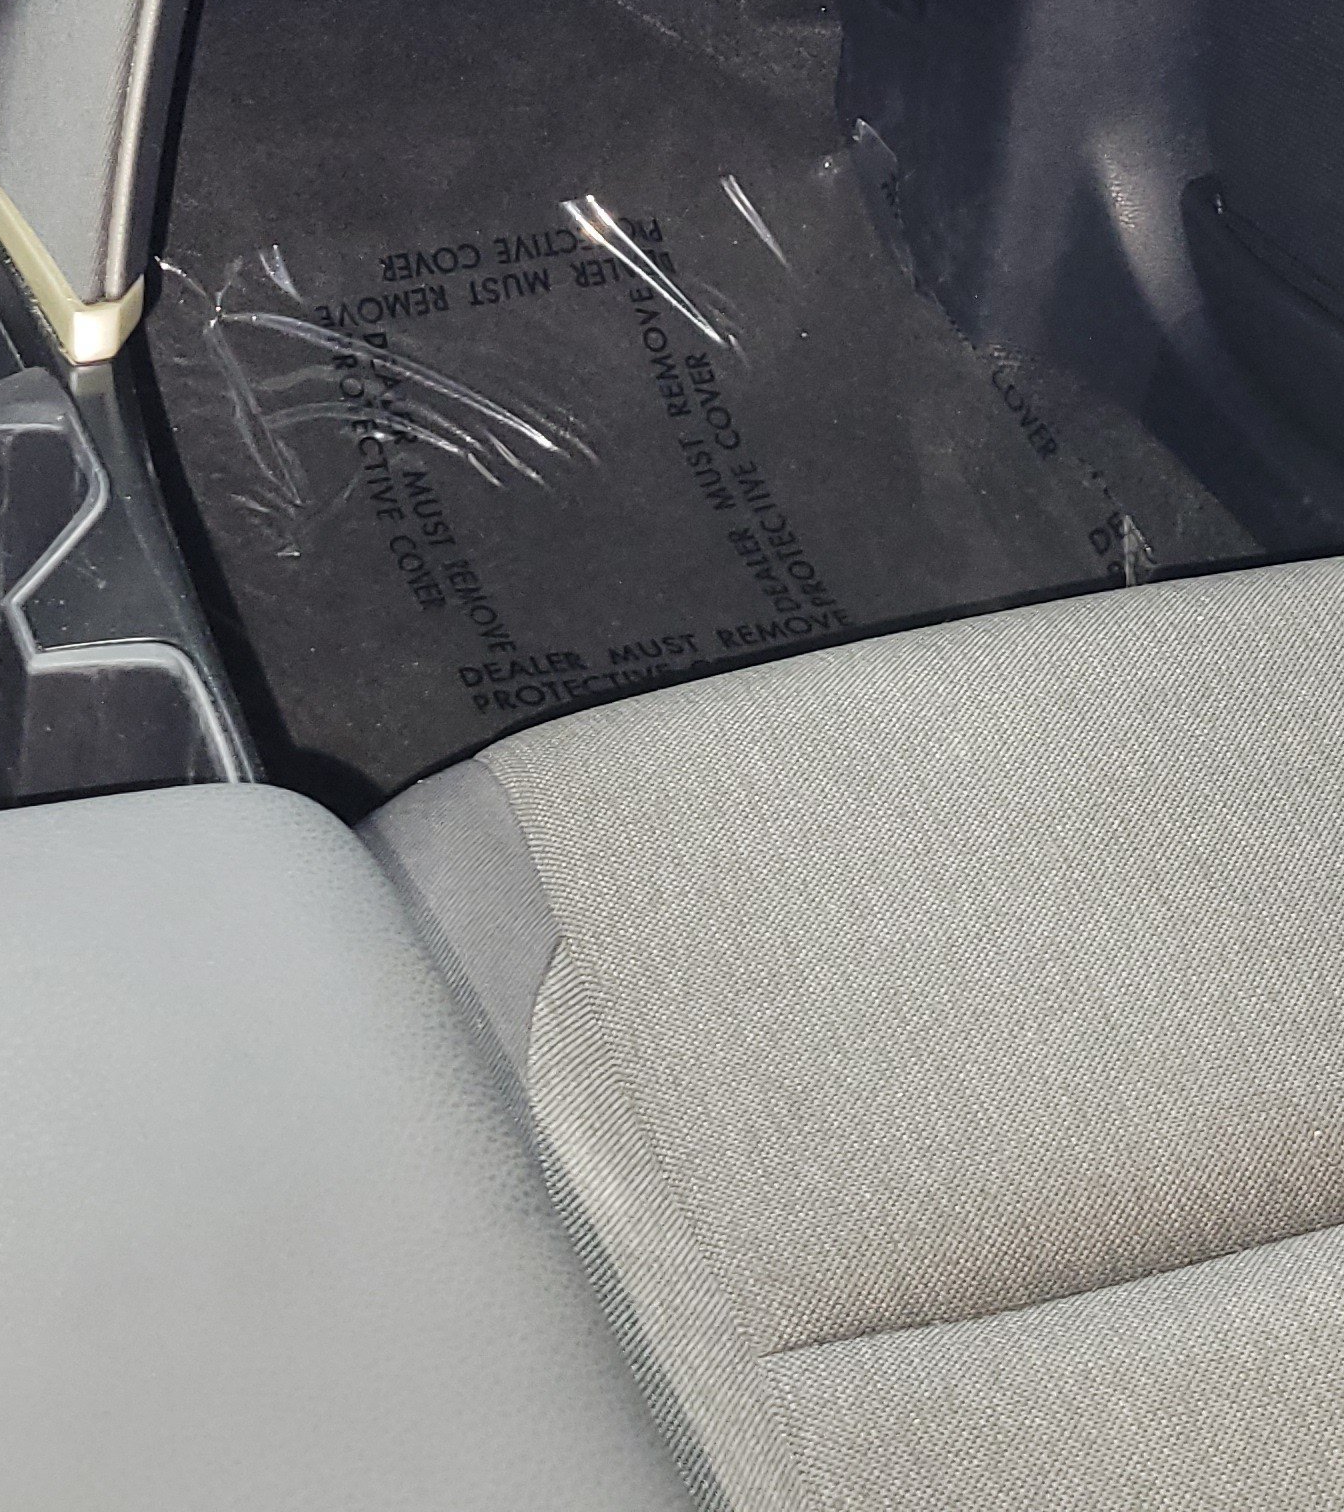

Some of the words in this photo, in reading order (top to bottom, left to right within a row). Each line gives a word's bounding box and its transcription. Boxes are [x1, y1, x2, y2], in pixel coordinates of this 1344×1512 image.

[380, 243, 481, 282] COVER
[469, 268, 552, 306] MUST
[315, 285, 449, 327] REMOVE
[630, 288, 691, 418] REMOVE
[685, 351, 740, 451] COVER
[403, 470, 456, 546] MUST
[678, 436, 736, 511] MUST
[729, 527, 802, 614] DEALER
[732, 460, 836, 608] PROTECTIVE
[389, 535, 446, 611] COVER
[456, 651, 588, 688] DEALER
[608, 633, 696, 666] MUST
[716, 608, 853, 650] REMOVE
